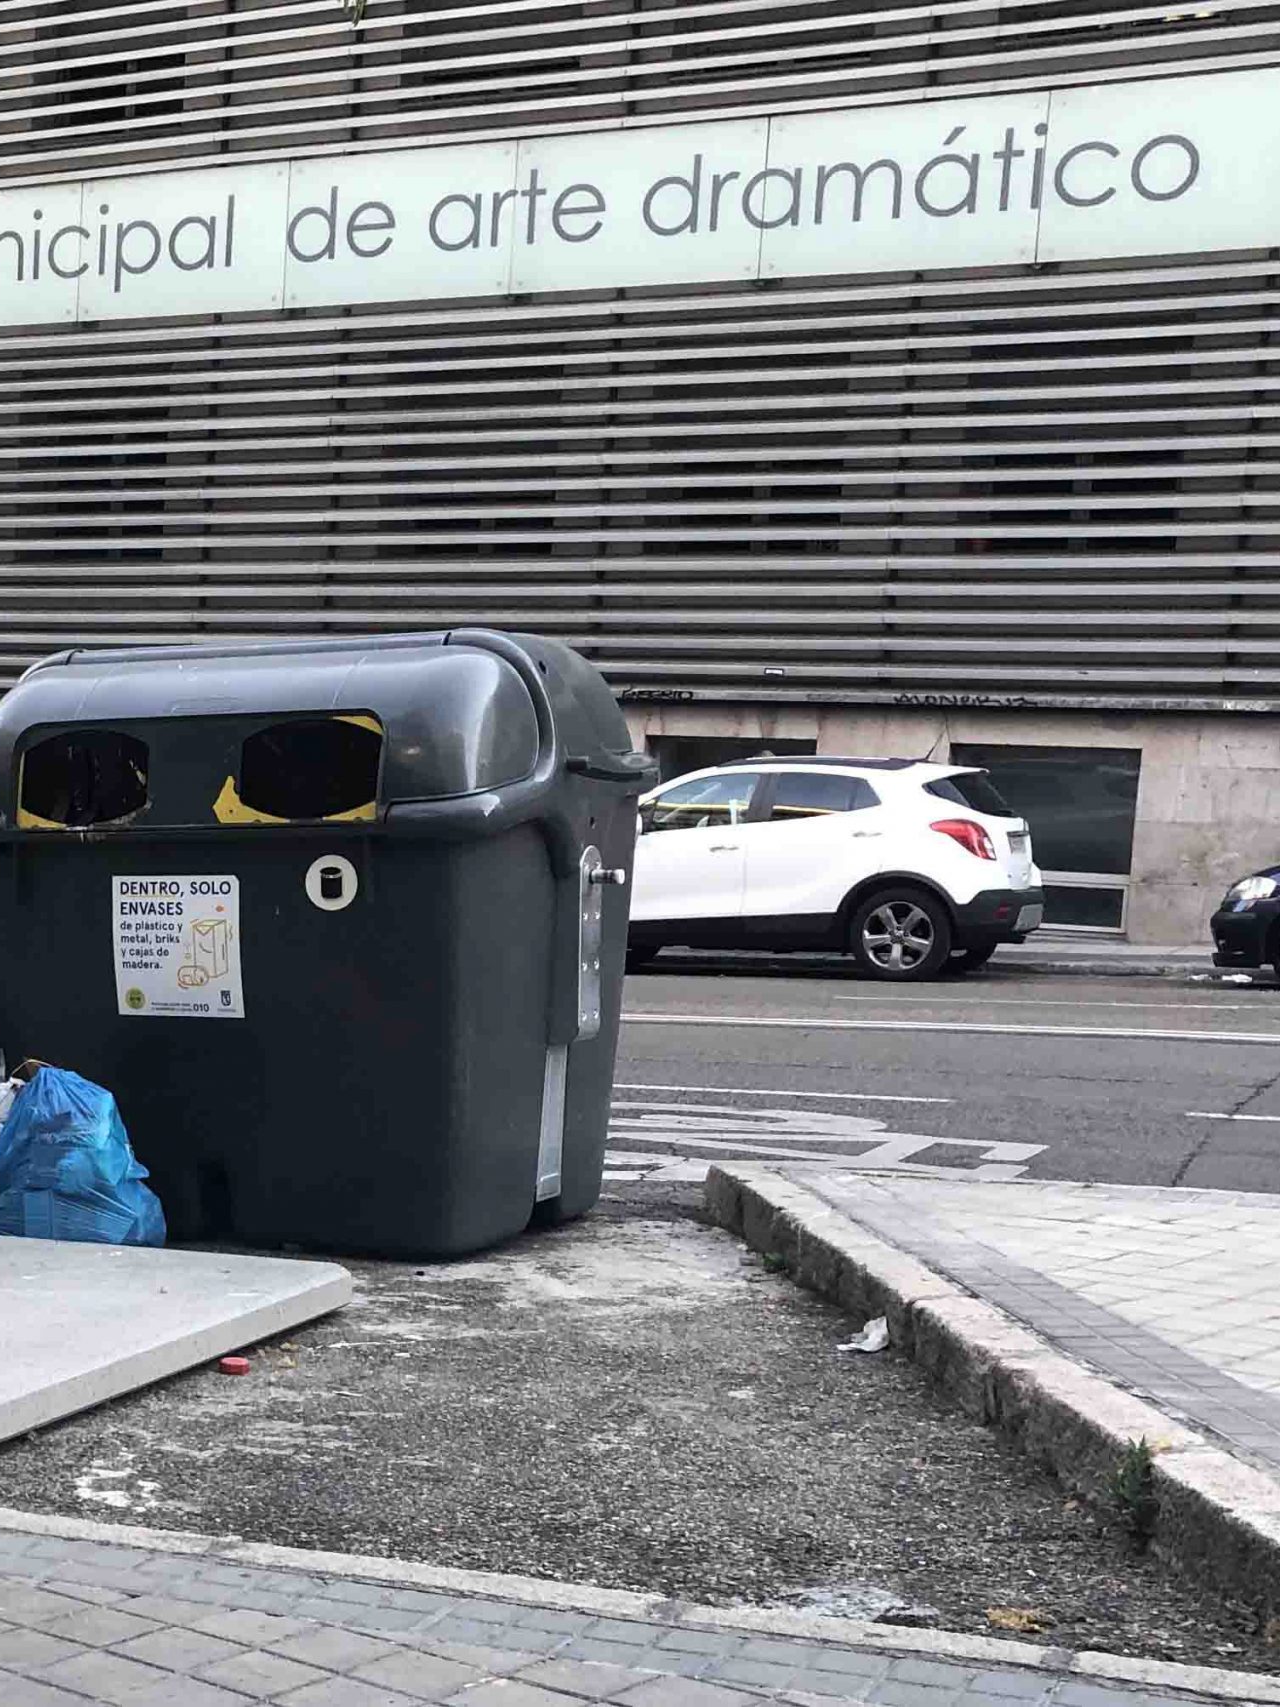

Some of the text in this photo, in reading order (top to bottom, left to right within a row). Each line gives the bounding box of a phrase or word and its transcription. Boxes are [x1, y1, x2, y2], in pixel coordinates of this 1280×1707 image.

[287, 185, 396, 262] de
[428, 168, 607, 251] arte
[643, 123, 1201, 236] dramático
[120, 881, 231, 897] DENTRO, SOLO
[120, 902, 183, 916] ENVASES
[120, 920, 183, 933] de plástico y
[120, 934, 180, 945] metal, briks
[121, 947, 169, 959] y cajas de
[122, 959, 163, 969] madera.
[193, 1003, 210, 1012] 010
